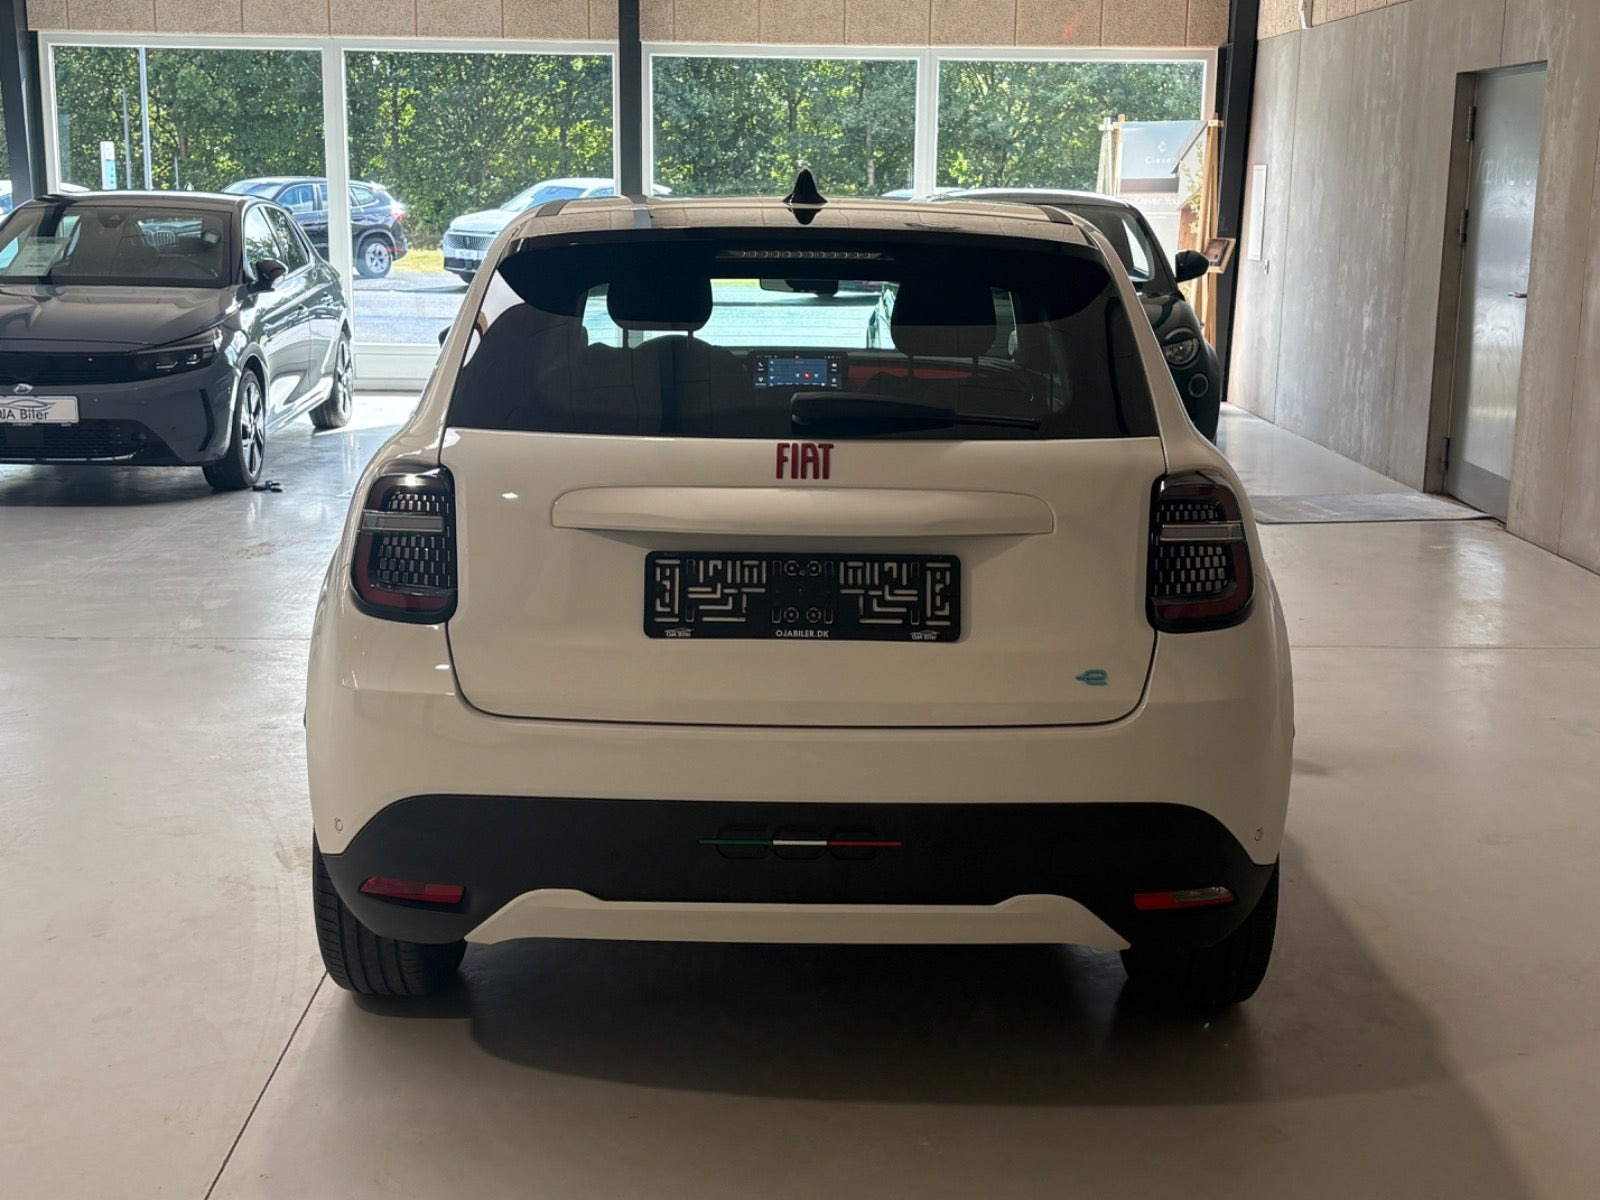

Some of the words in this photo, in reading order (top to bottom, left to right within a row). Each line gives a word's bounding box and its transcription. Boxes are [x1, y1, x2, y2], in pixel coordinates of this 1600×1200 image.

[20, 409, 49, 420] Biler
[776, 443, 834, 479] FIAT
[775, 629, 829, 638] OJABILER.DK
